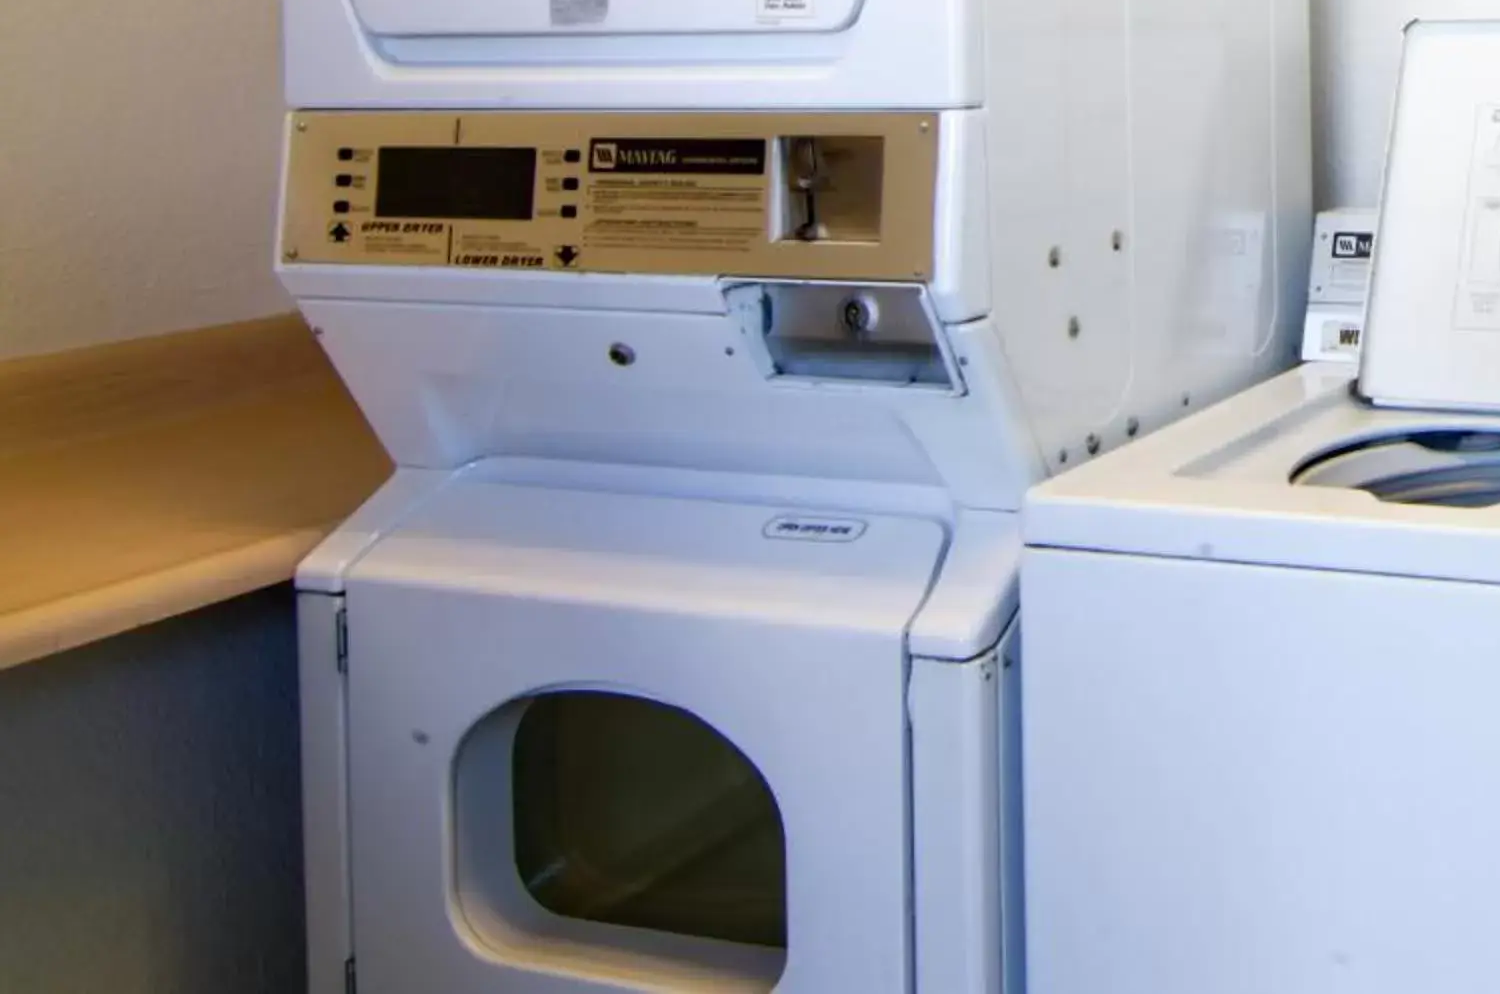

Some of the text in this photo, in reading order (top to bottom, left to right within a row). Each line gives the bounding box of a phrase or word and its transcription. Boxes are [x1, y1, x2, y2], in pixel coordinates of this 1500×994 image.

[619, 149, 678, 165] MAYTAG
[361, 223, 444, 234] UPPER DRYER
[454, 255, 544, 267] LOWER DRYER
